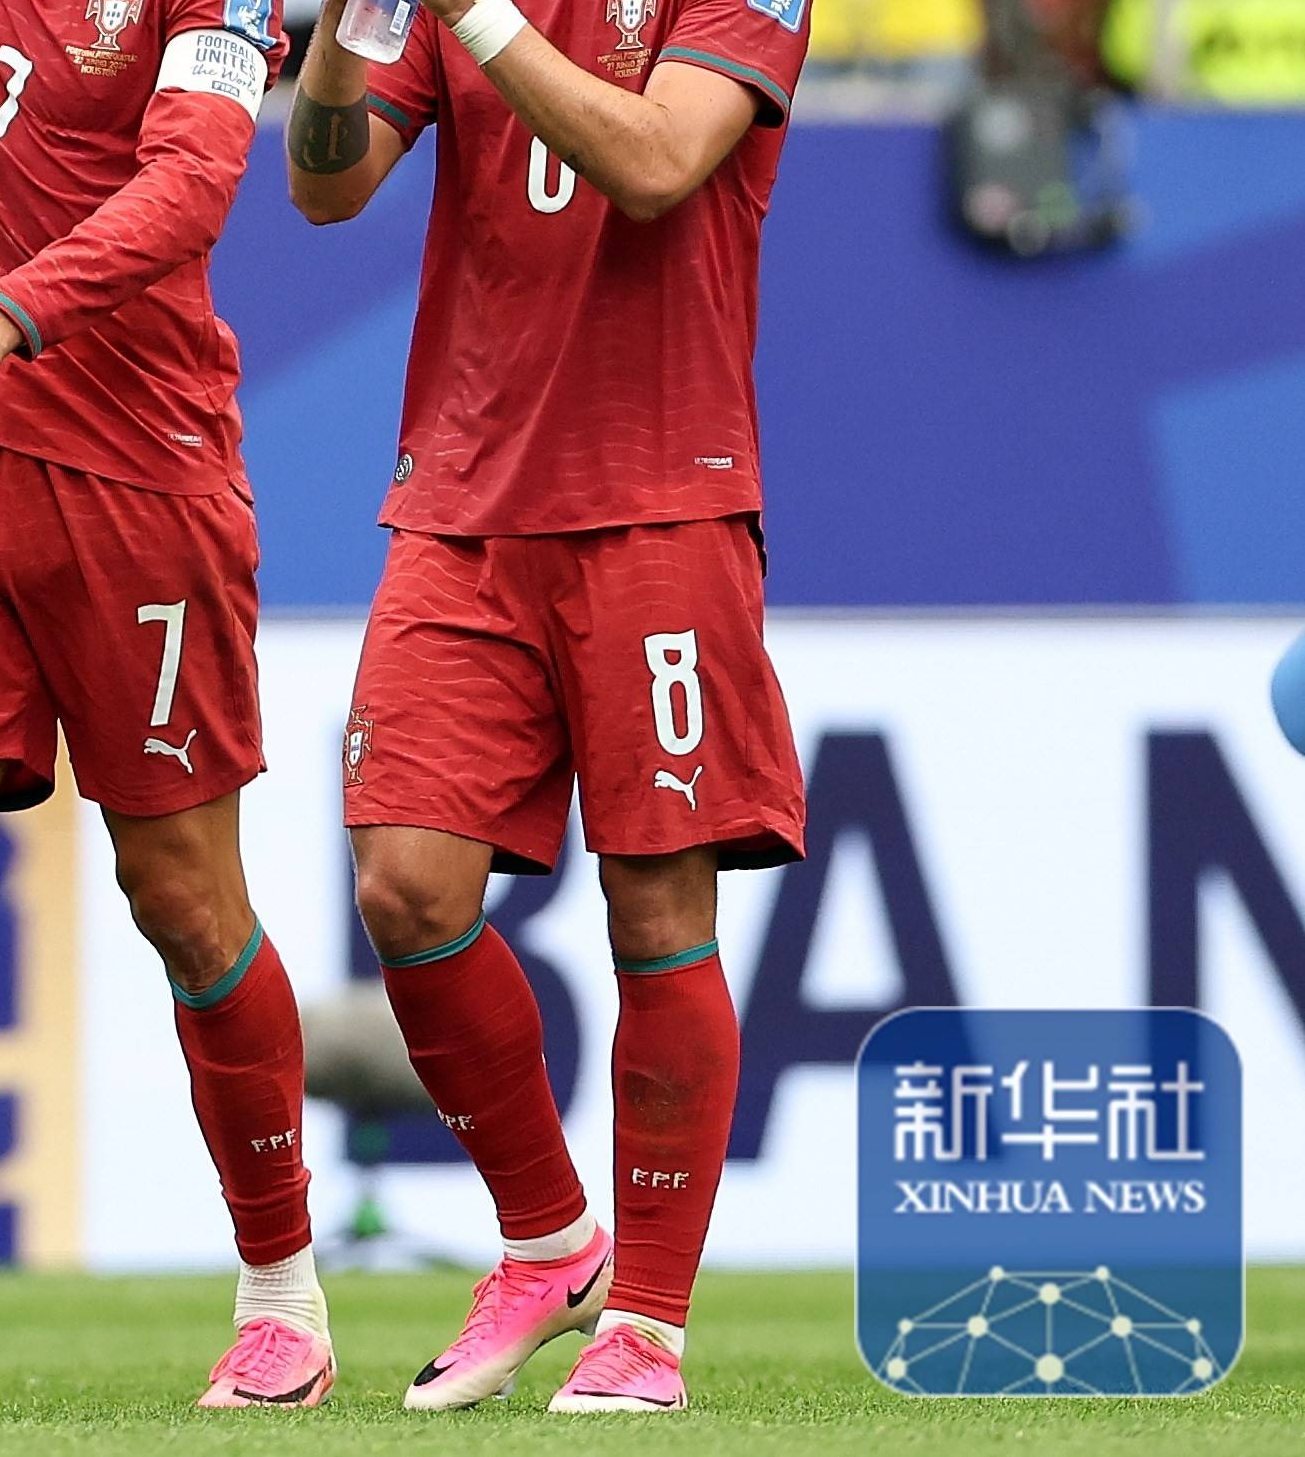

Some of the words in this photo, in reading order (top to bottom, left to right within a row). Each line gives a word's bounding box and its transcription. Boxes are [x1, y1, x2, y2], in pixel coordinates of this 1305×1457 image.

[195, 48, 257, 82] UNITES
[196, 34, 254, 63] FOOTBALL
[190, 63, 218, 76] the
[137, 599, 186, 727] 7
[644, 628, 703, 756] 8
